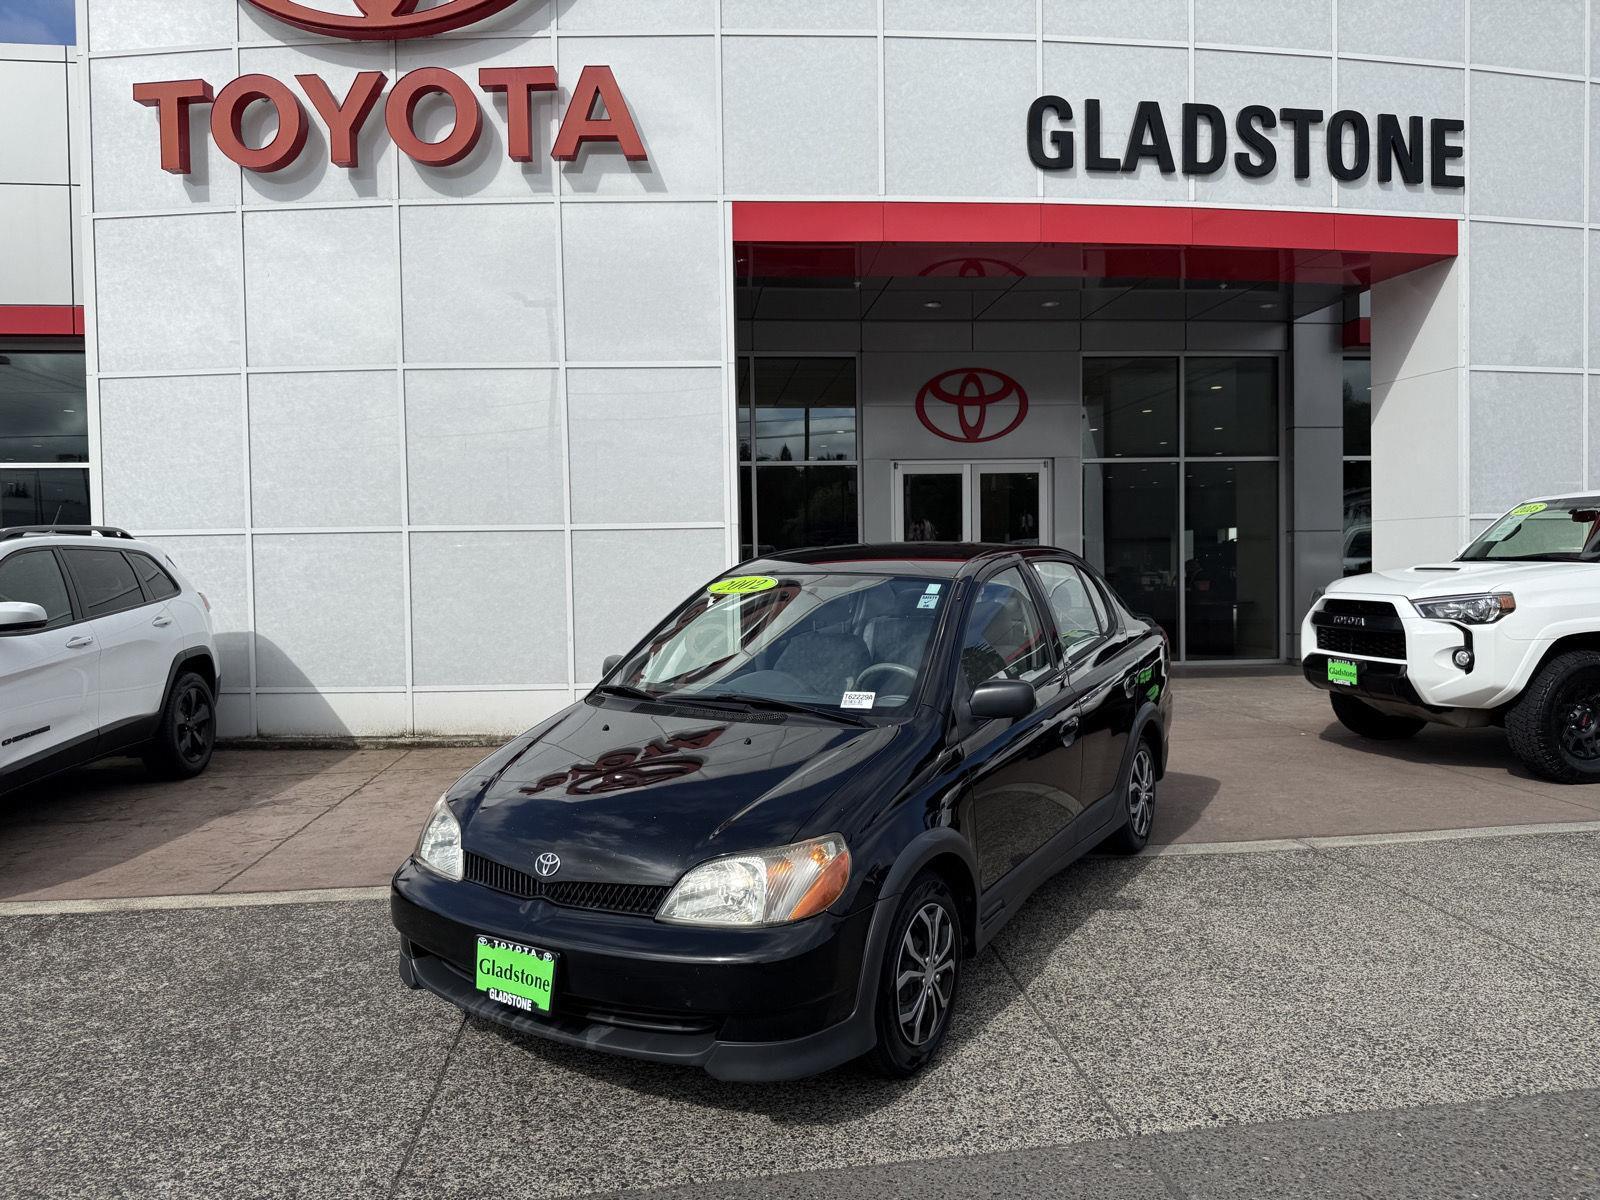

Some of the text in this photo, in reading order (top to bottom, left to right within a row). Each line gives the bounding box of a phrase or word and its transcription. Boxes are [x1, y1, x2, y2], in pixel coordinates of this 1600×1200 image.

[133, 65, 647, 174] TOYOTA
[1027, 95, 1465, 187] GLADSTONE
[715, 579, 769, 592] 2002
[1333, 615, 1365, 627] TOYOTA
[1328, 666, 1357, 679] Gladstone
[493, 940, 537, 957] TOYOTA
[479, 958, 550, 992] Gladstone
[489, 988, 532, 1011] GLADSTONE
